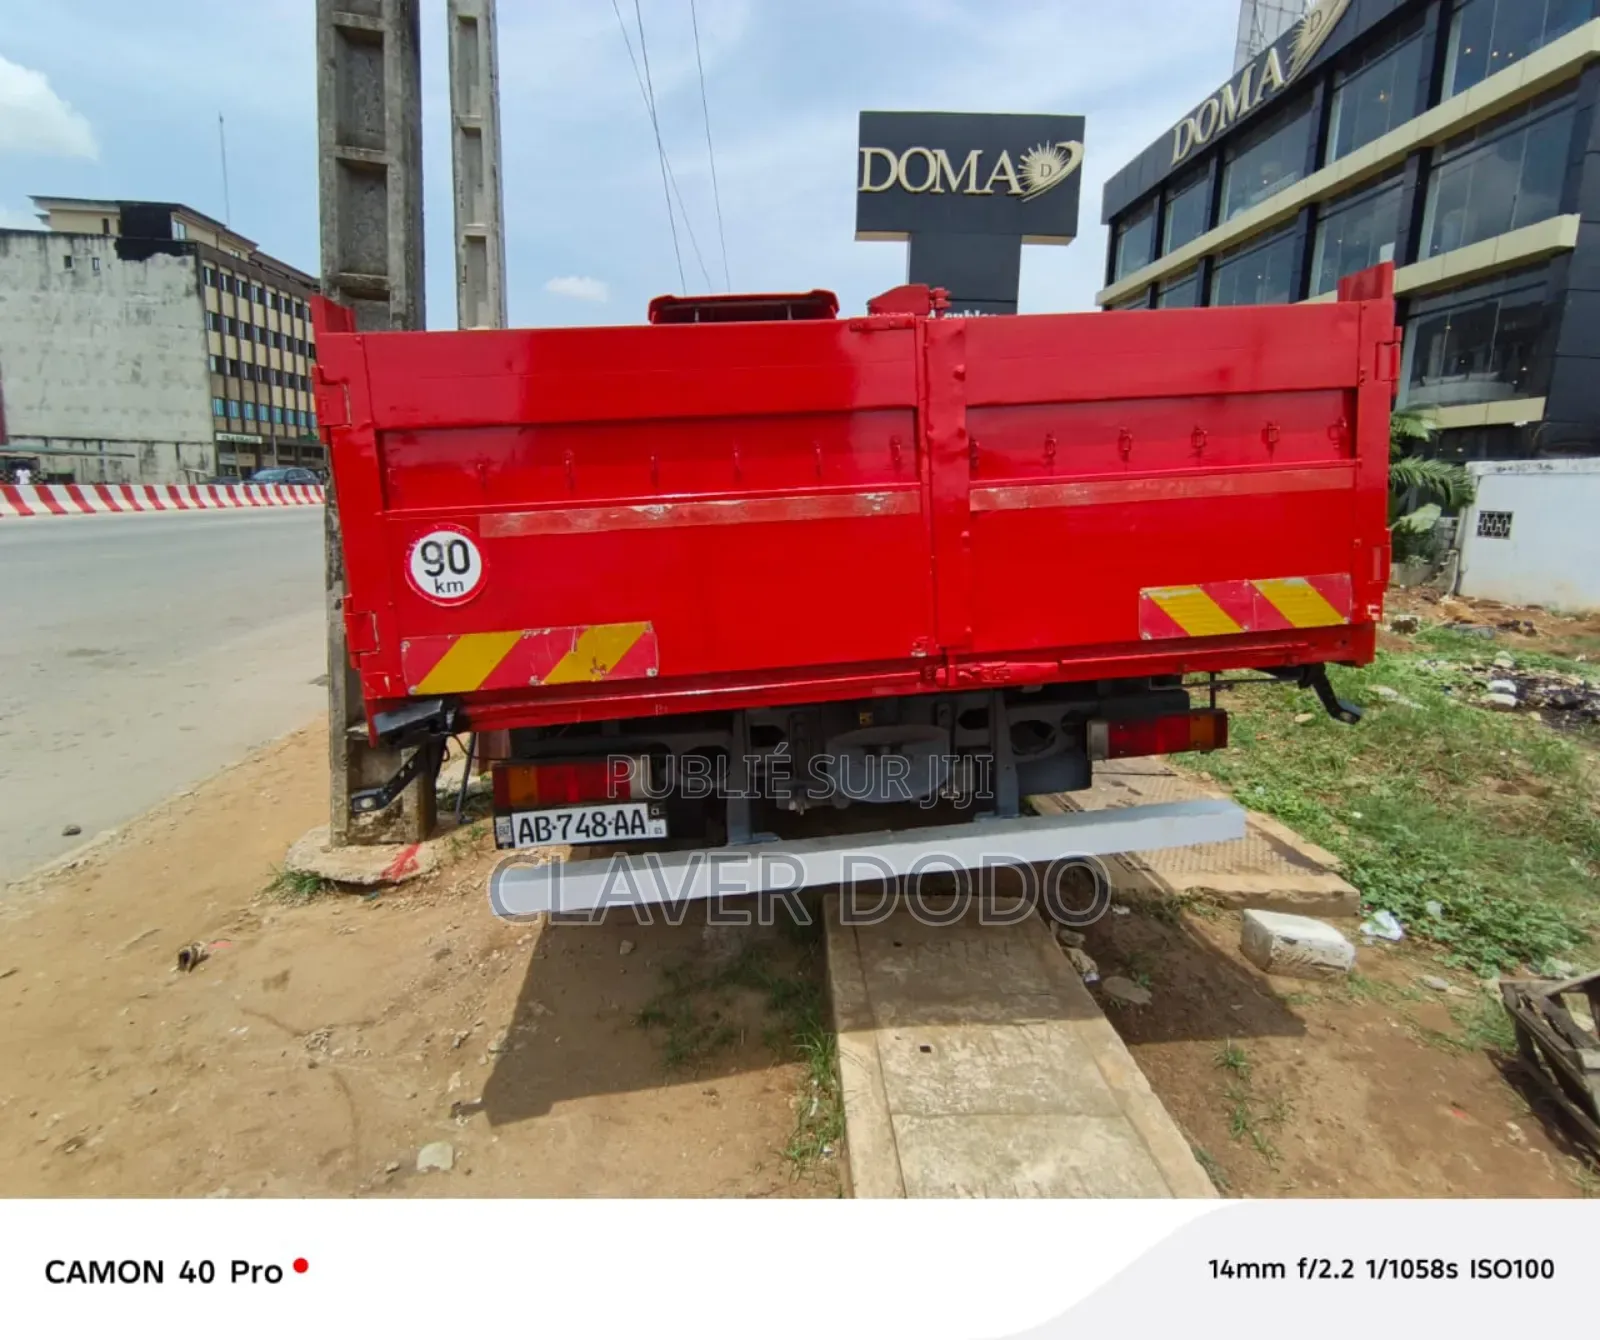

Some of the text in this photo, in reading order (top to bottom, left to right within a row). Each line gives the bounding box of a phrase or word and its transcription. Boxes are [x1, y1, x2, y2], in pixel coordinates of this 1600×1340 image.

[1171, 47, 1284, 166] DOMA
[858, 147, 1025, 194] DOMA
[420, 539, 471, 577] 90
[434, 578, 464, 594] km
